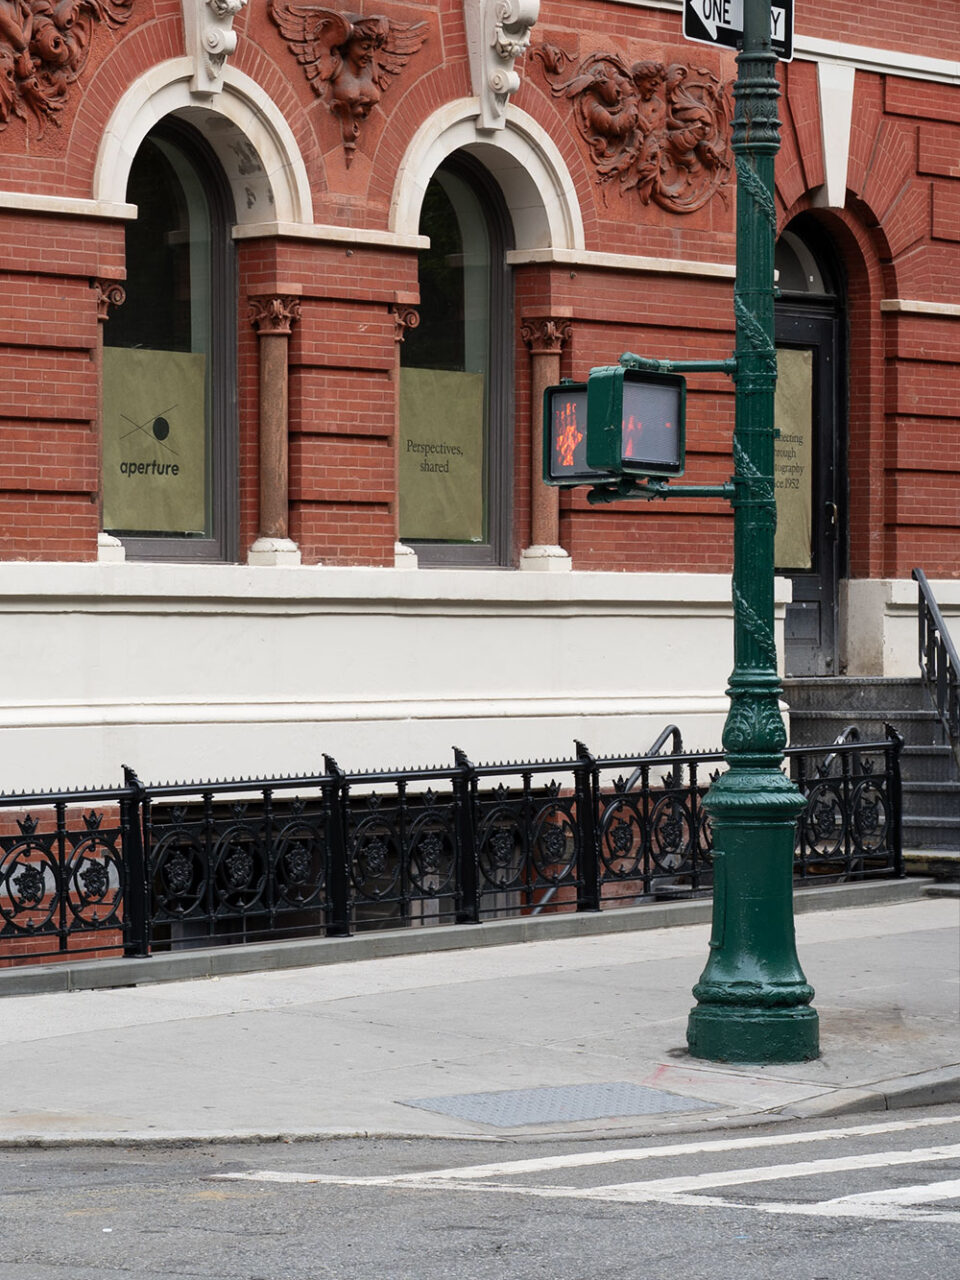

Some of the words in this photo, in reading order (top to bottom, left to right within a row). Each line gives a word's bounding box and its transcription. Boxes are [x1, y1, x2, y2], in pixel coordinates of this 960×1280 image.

[406, 439, 463, 457] Perspectives,
[120, 459, 180, 477] aperture
[420, 458, 449, 472] shared
